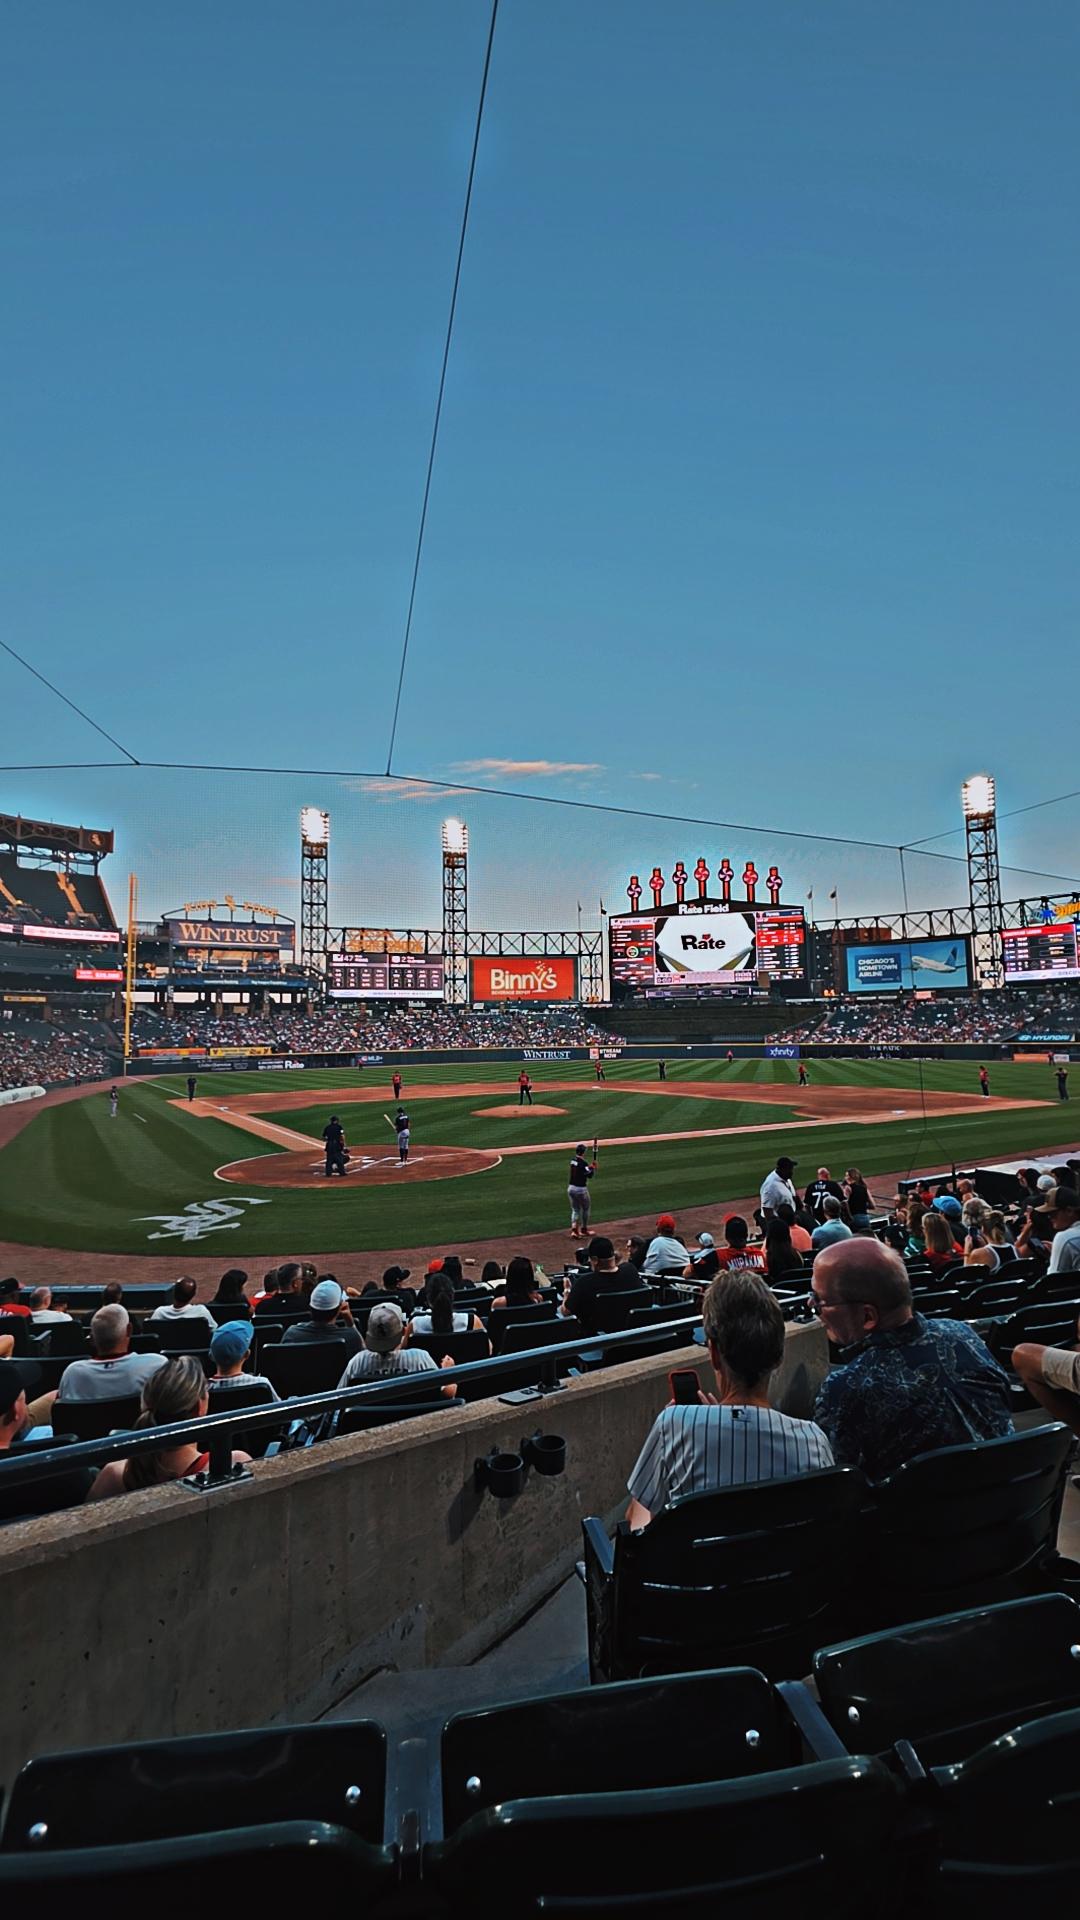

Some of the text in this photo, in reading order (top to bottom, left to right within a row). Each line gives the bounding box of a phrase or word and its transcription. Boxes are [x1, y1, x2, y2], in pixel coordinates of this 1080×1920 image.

[678, 903, 729, 914] Rate Field
[681, 934, 726, 950] Rate
[769, 1047, 795, 1057] xfinity
[285, 1060, 305, 1070] Rate
